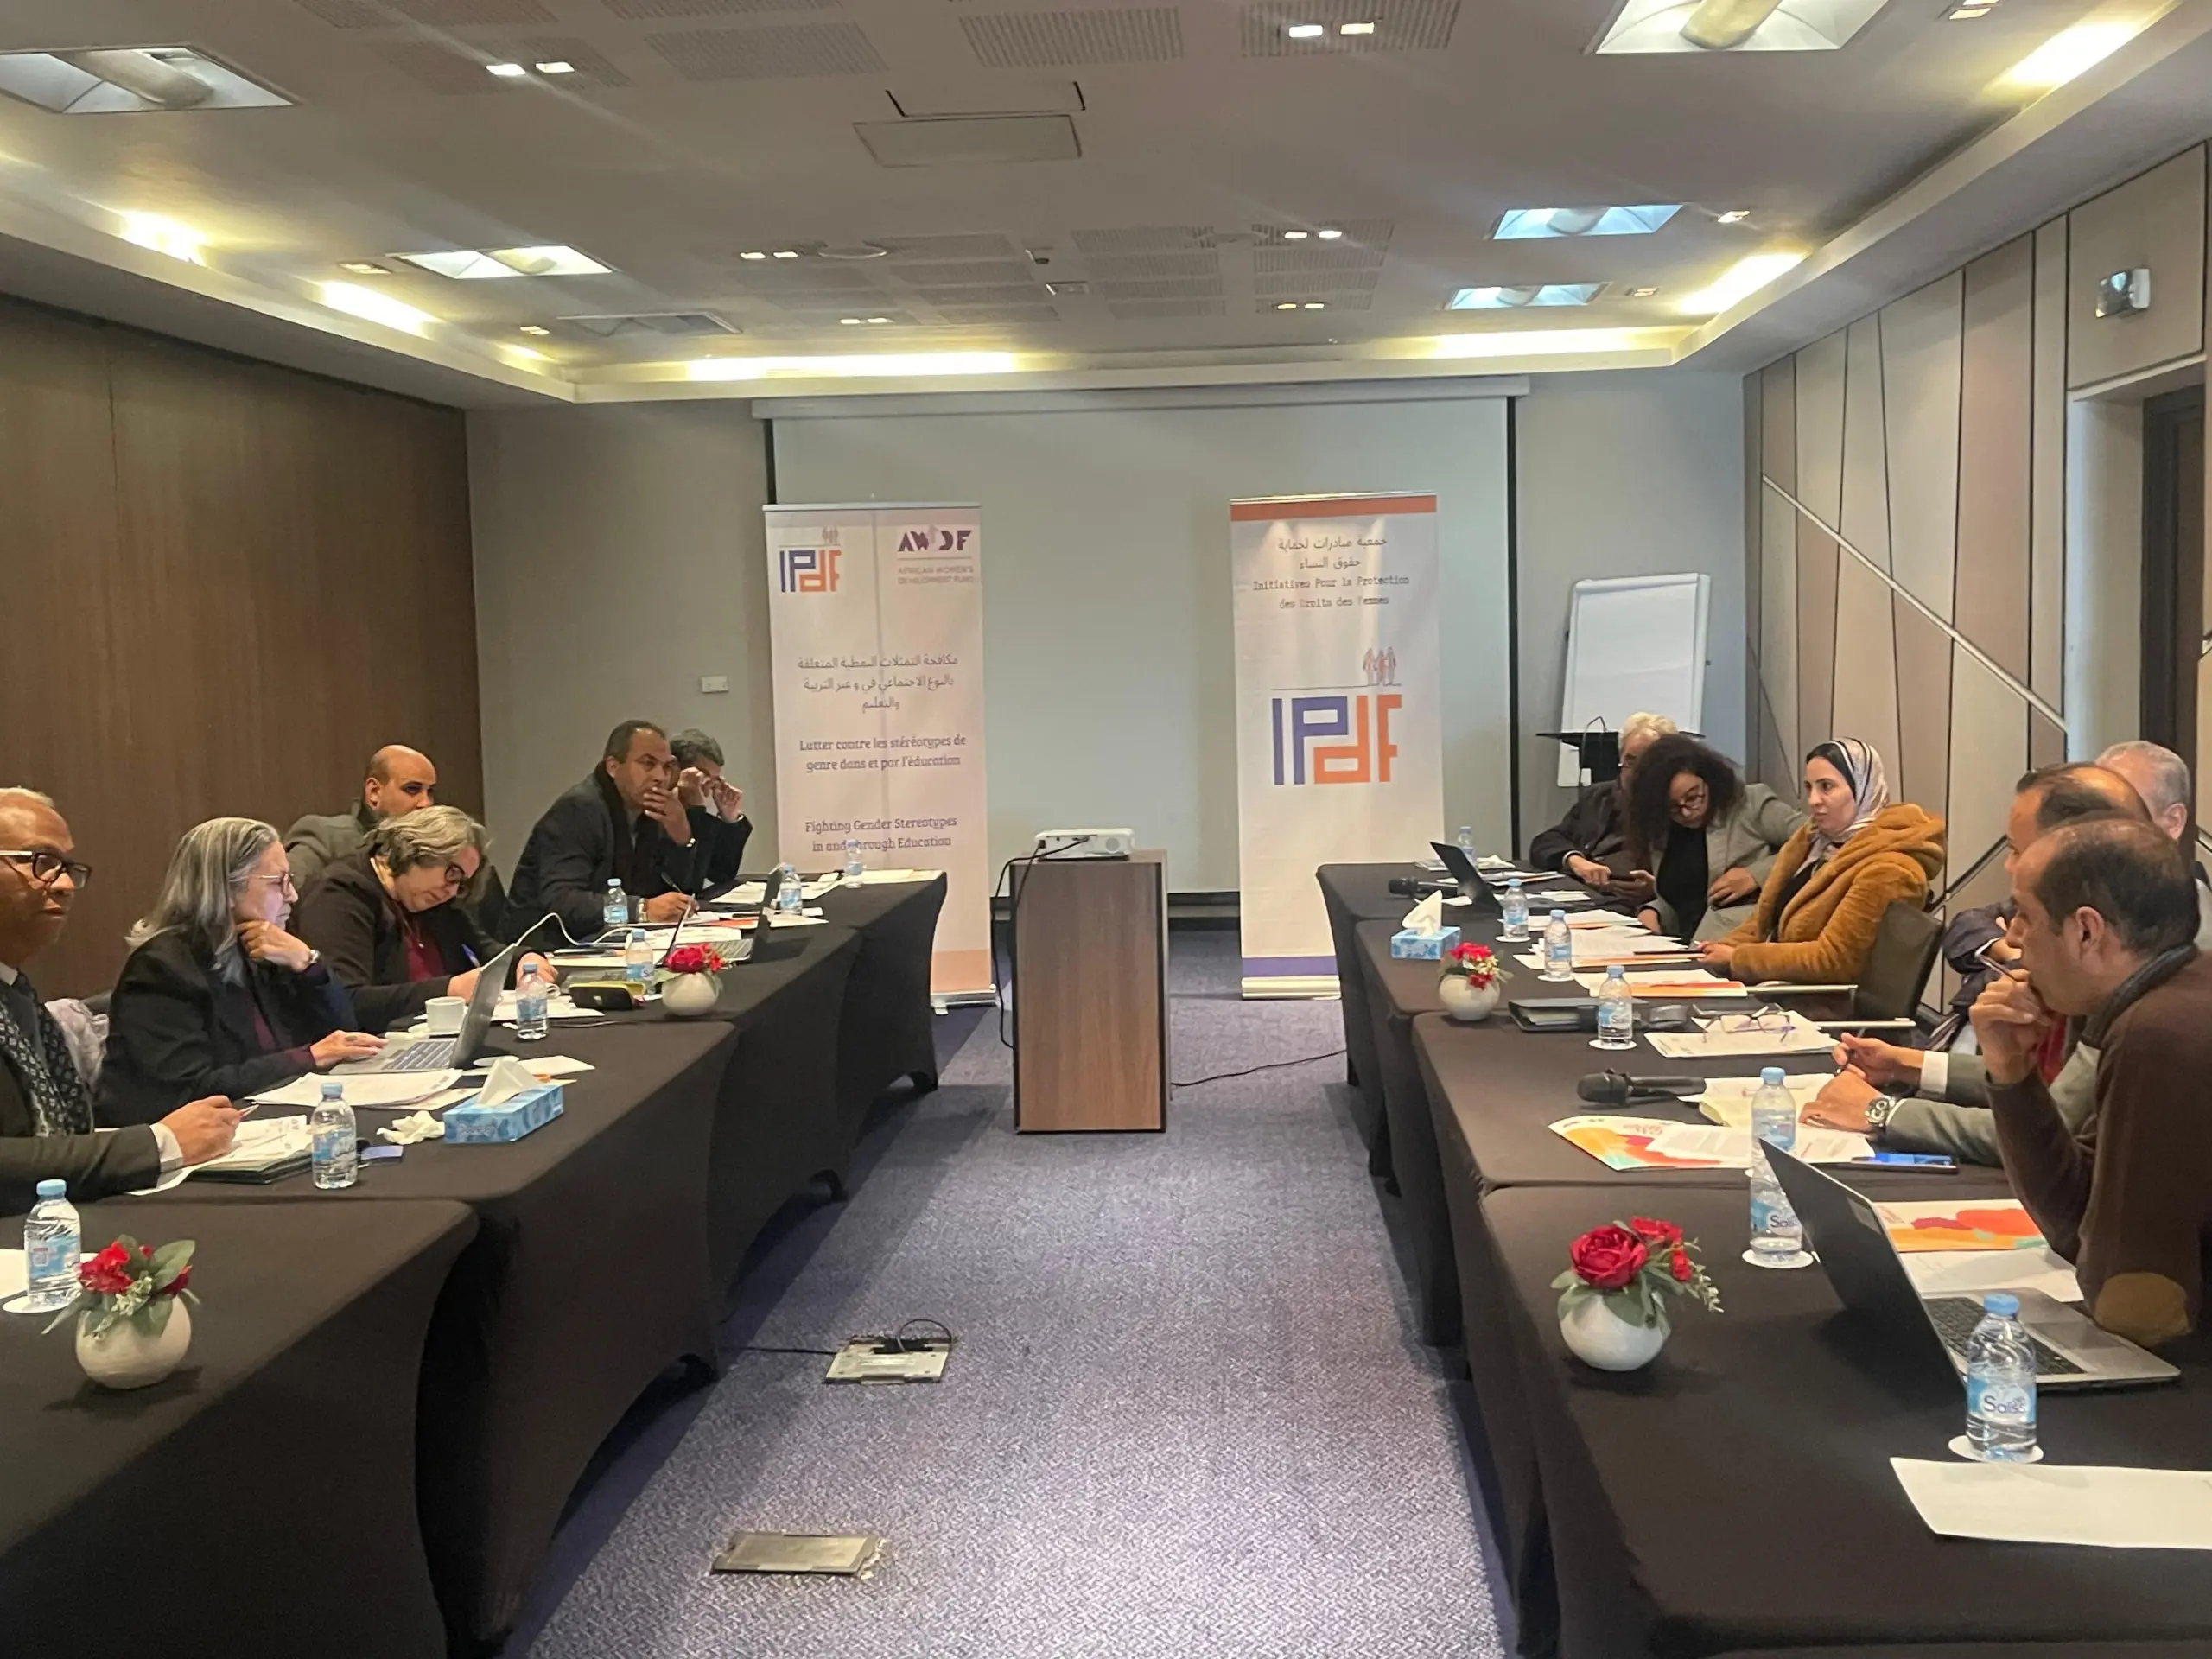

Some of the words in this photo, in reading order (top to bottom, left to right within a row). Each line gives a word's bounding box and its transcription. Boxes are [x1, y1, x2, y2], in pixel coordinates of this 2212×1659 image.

[1253, 579, 1311, 591] Initiatives
[1315, 577, 1337, 588] Pour
[1342, 576, 1352, 587] la
[1357, 575, 1409, 587] Protection
[1279, 599, 1295, 609] des
[1337, 597, 1352, 607] des
[799, 740, 834, 751] Lutter
[836, 739, 871, 750] contre
[873, 738, 888, 749] les
[890, 735, 951, 749] stéréotypes
[953, 734, 966, 746] de
[806, 760, 837, 772] genre
[840, 758, 867, 770] dans
[868, 758, 879, 769] et
[880, 757, 900, 771] par
[901, 754, 961, 767] l'éducation
[804, 821, 851, 835] Fighting
[853, 819, 893, 830] Gender
[894, 817, 957, 830] Stereotypes
[812, 841, 823, 852] in
[826, 840, 846, 852] and
[849, 838, 896, 852] hrough
[898, 836, 951, 849] Education
